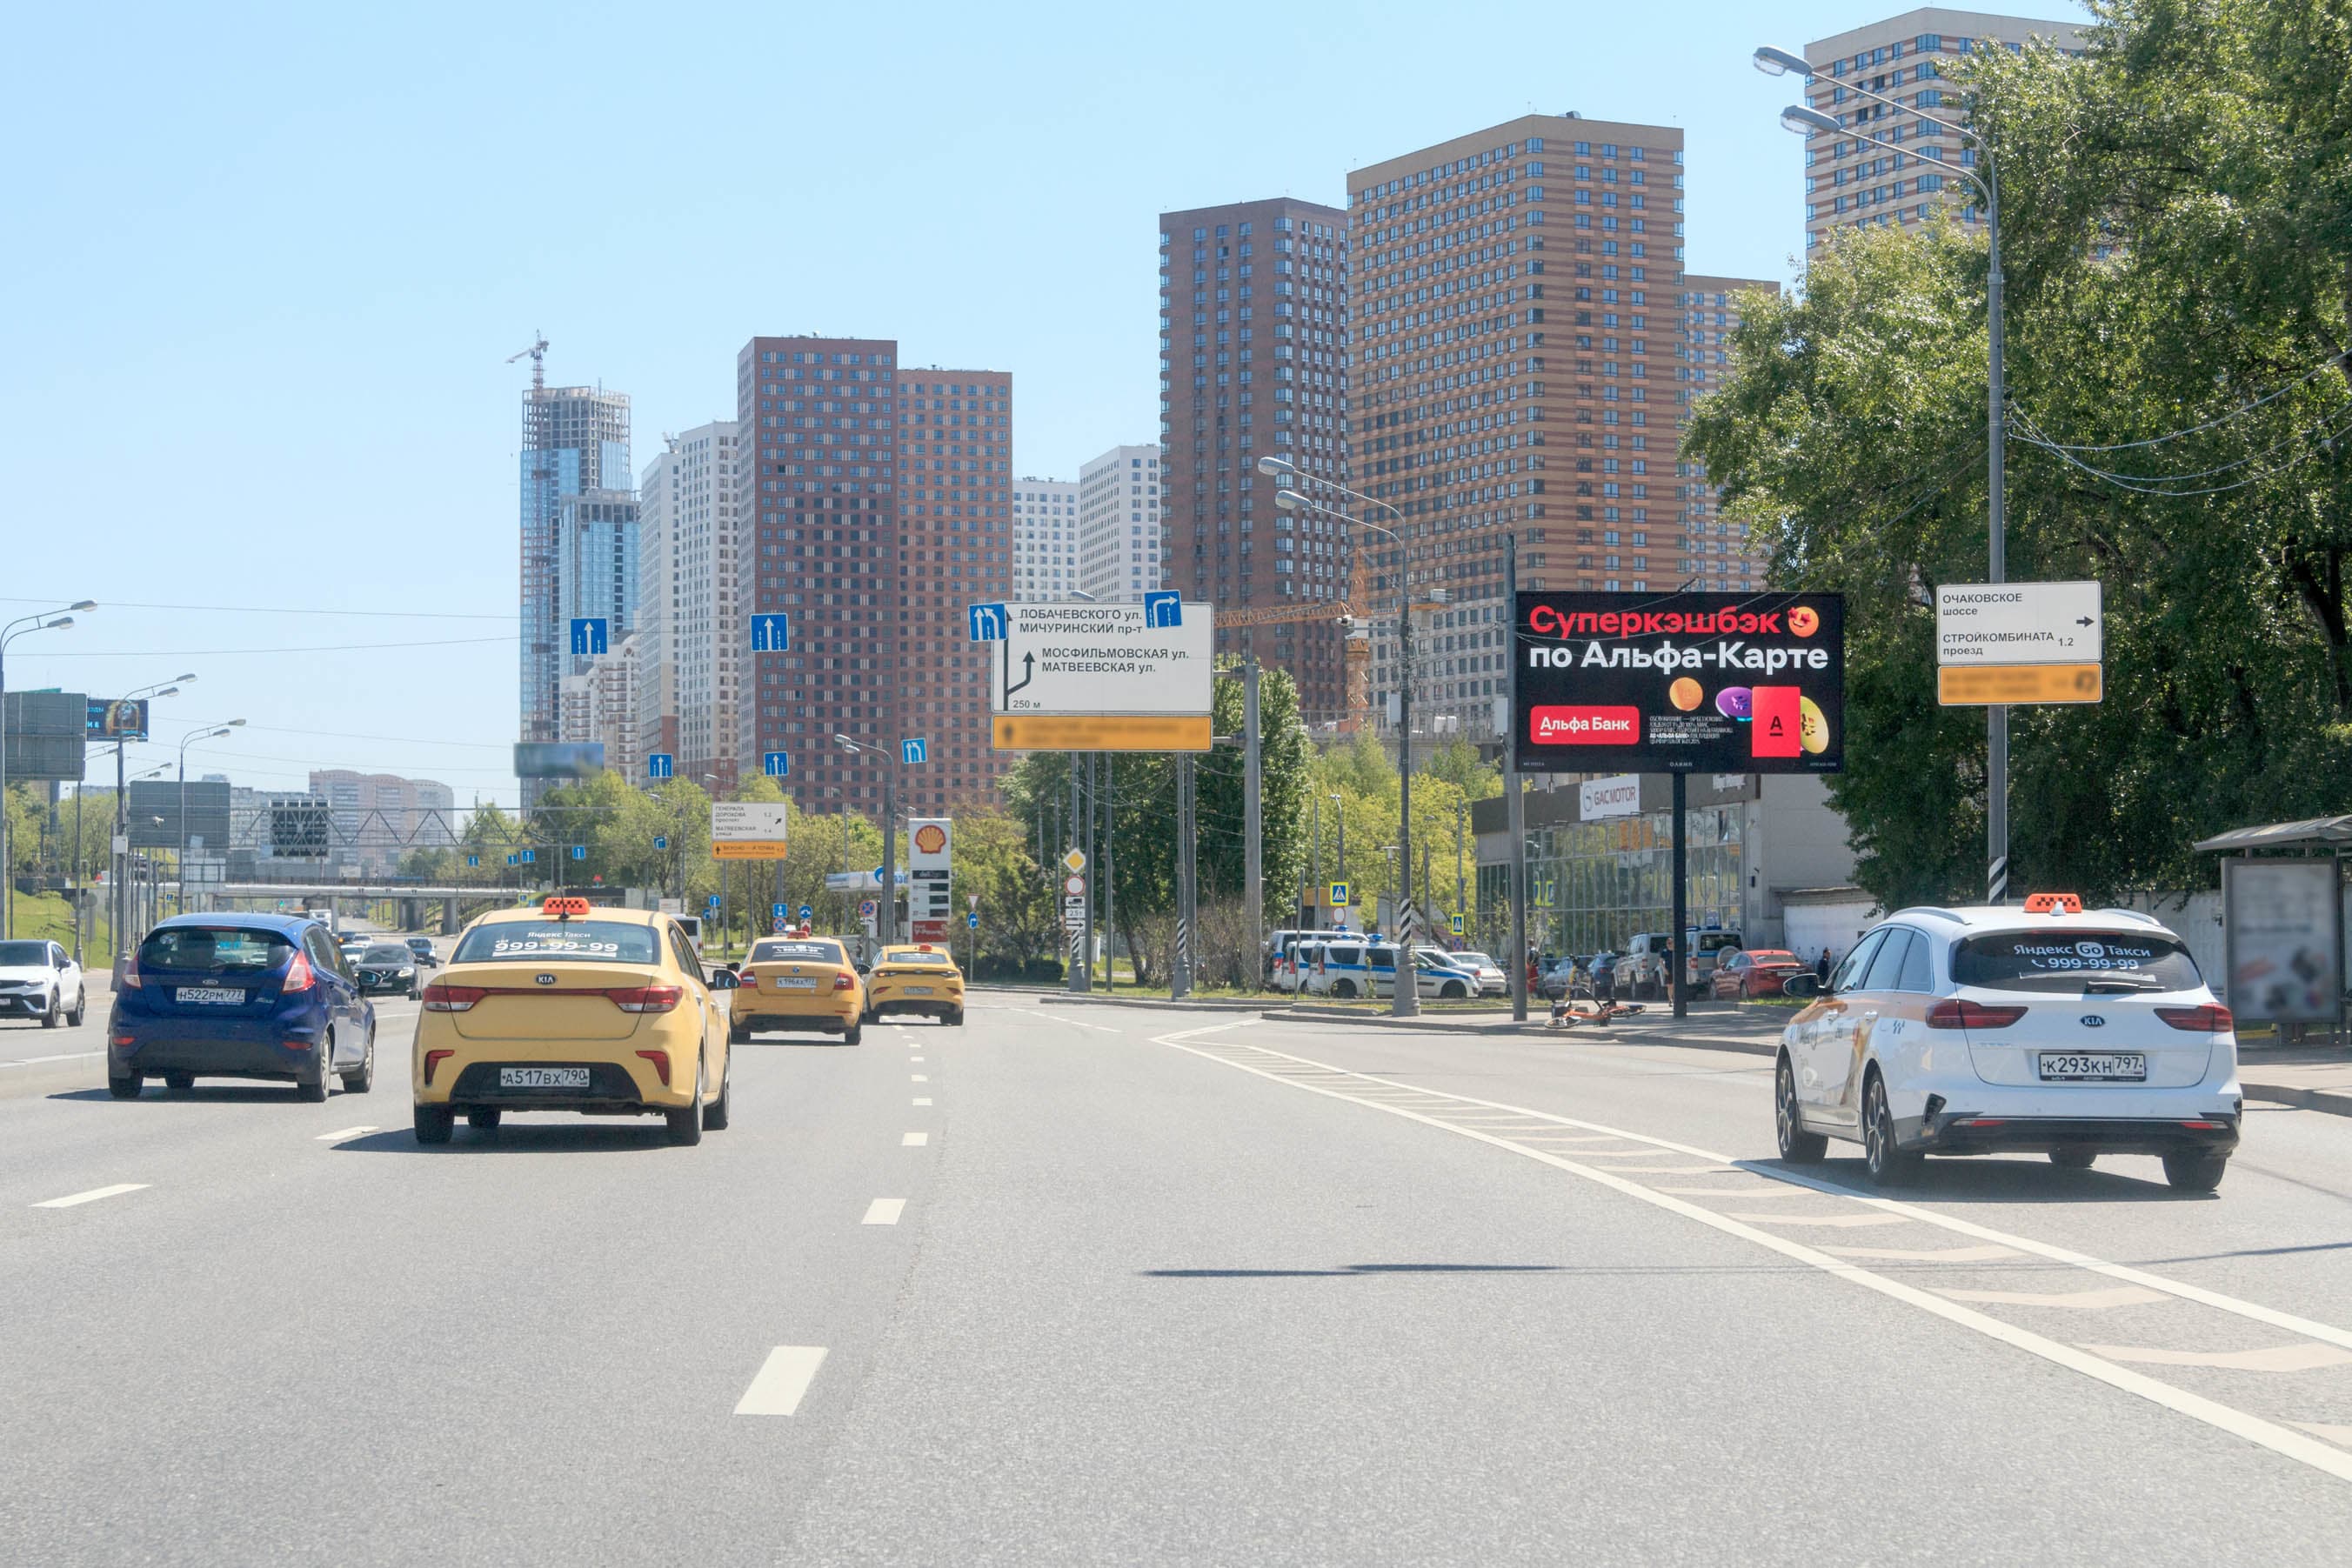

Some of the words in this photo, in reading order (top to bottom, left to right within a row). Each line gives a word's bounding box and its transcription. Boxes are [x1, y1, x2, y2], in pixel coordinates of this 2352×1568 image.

[1942, 593, 2022, 604] ОЧАКОВСКОЕ
[1019, 610, 1121, 619] ЛОБАЧЕВСКОГО
[1125, 611, 1142, 622] ул.
[1529, 604, 1781, 639] Суперкэшбэк
[1019, 621, 1114, 633] МИЧУРИНСКИЙ
[1118, 626, 1143, 636] пр-т
[1942, 631, 2055, 643] СТРОЙКОМБИНАТА
[2058, 637, 2074, 647] 1.2
[1042, 648, 1168, 658] МОСФИЛЬМОВСКАЯ
[1172, 650, 1189, 660] ул.
[1529, 646, 1573, 668] по
[1580, 641, 1828, 675] Альфа-Карте
[1943, 647, 1983, 657] проезд
[1042, 662, 1135, 672] МАТВЕЕВСКАЯ
[1139, 664, 1156, 674] ул.
[1012, 700, 1031, 709] 250
[1540, 717, 1589, 734] Альфа
[1592, 717, 1630, 731] Банк
[1594, 790, 1610, 806] GAC
[1610, 786, 1636, 803] MOTOR
[494, 941, 619, 952] 999-99-99
[2014, 944, 2073, 956] Яндекс
[2078, 944, 2102, 956] Go
[2105, 944, 2151, 957] Такси
[2048, 957, 2139, 970] 999-99-99
[179, 990, 224, 1000] Н522РМ
[226, 990, 242, 998] 777
[2083, 1017, 2102, 1026] KIA
[2047, 1057, 2113, 1073] К293КН
[2115, 1057, 2139, 1069] 797
[505, 1070, 561, 1084] А517ВХ
[564, 1070, 585, 1080] 790
